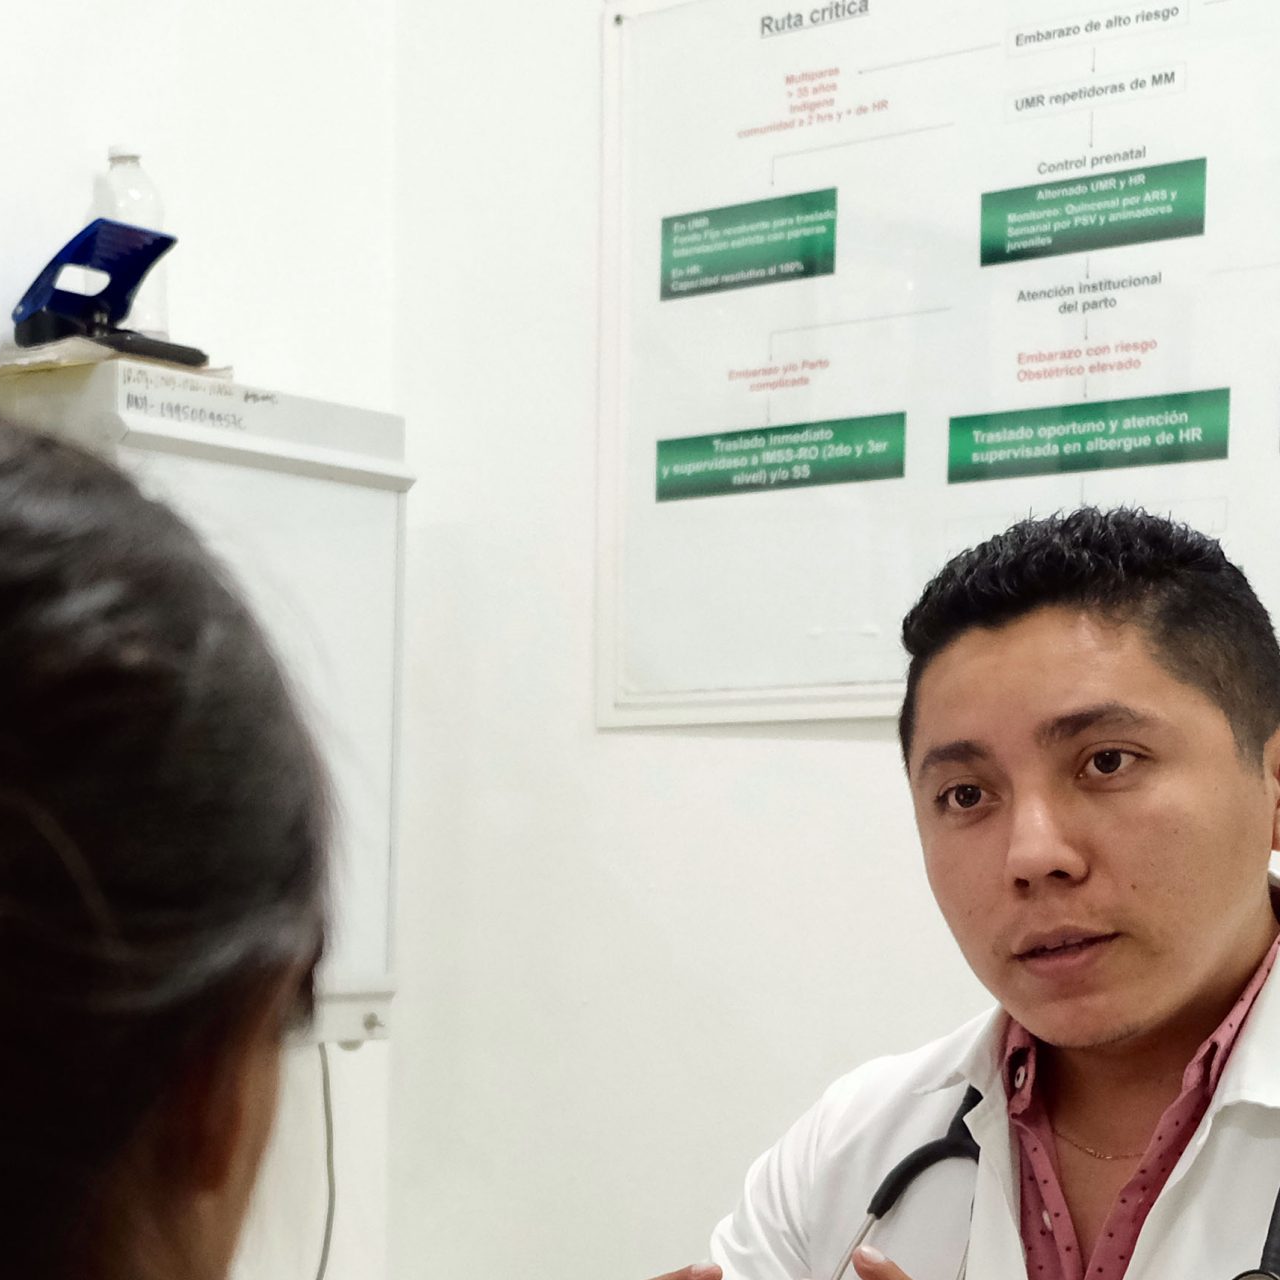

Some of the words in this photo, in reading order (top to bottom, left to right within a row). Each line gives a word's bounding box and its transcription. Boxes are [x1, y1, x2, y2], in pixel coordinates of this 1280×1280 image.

[761, 12, 803, 35] Ruta
[1015, 24, 1080, 47] Embarazo
[1084, 20, 1101, 33] de
[1105, 15, 1131, 29] alto
[1135, 6, 1179, 24] riesgo
[1015, 95, 1045, 112] UMR
[1049, 81, 1125, 106] repetidoras
[1130, 78, 1146, 91] de
[1151, 71, 1175, 87] MM
[1038, 155, 1086, 176] Control
[1091, 146, 1146, 168] prenatal
[1109, 204, 1173, 222] animadores
[1017, 284, 1074, 303] Atención
[1078, 272, 1162, 294] institucional
[1058, 300, 1078, 314] del
[1082, 297, 1117, 314] parto
[1017, 345, 1082, 365] Embarazo
[1086, 344, 1111, 356] con
[1115, 339, 1157, 354] riesgo
[1089, 357, 1141, 374] elevado
[713, 437, 766, 454] Traslado
[770, 427, 834, 445] inmediato
[972, 423, 1033, 445] Traslado
[1037, 421, 1105, 441] oportuno
[1122, 410, 1188, 430] atención
[972, 441, 1059, 464] supervisada
[1063, 440, 1081, 454] en
[1086, 431, 1152, 452] albergue
[1156, 431, 1174, 444] de
[1179, 428, 1202, 443] HR
